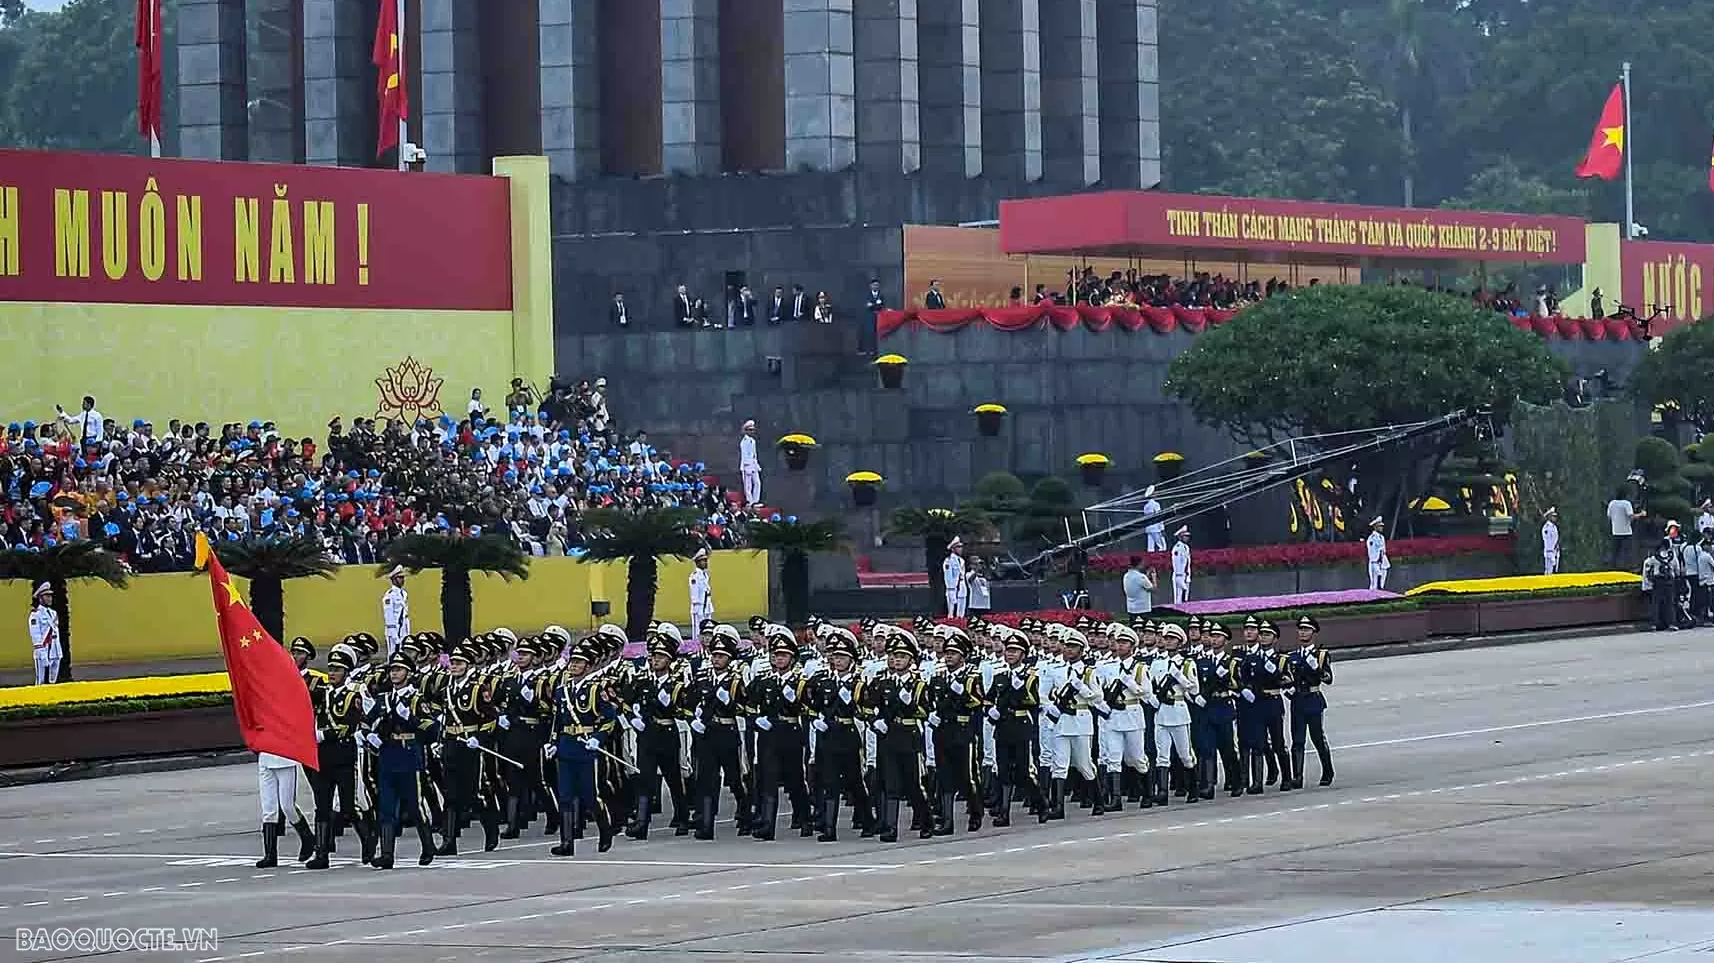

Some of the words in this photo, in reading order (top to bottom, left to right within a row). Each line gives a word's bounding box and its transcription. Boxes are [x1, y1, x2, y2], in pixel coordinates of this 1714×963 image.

[54, 177, 202, 280] MUÔN
[1166, 210, 1199, 236] TINH
[1242, 207, 1275, 240] CÁCH
[1278, 216, 1313, 247] MẠNG
[1316, 212, 1356, 244] THÁNG
[1360, 215, 1385, 246] TÁM
[1388, 218, 1404, 247] VÀ
[1406, 214, 1435, 249] QUỐC
[1439, 221, 1476, 249] KHÁNH
[1480, 227, 1500, 250] 2-9
[1643, 253, 1702, 321] NƯỚC
